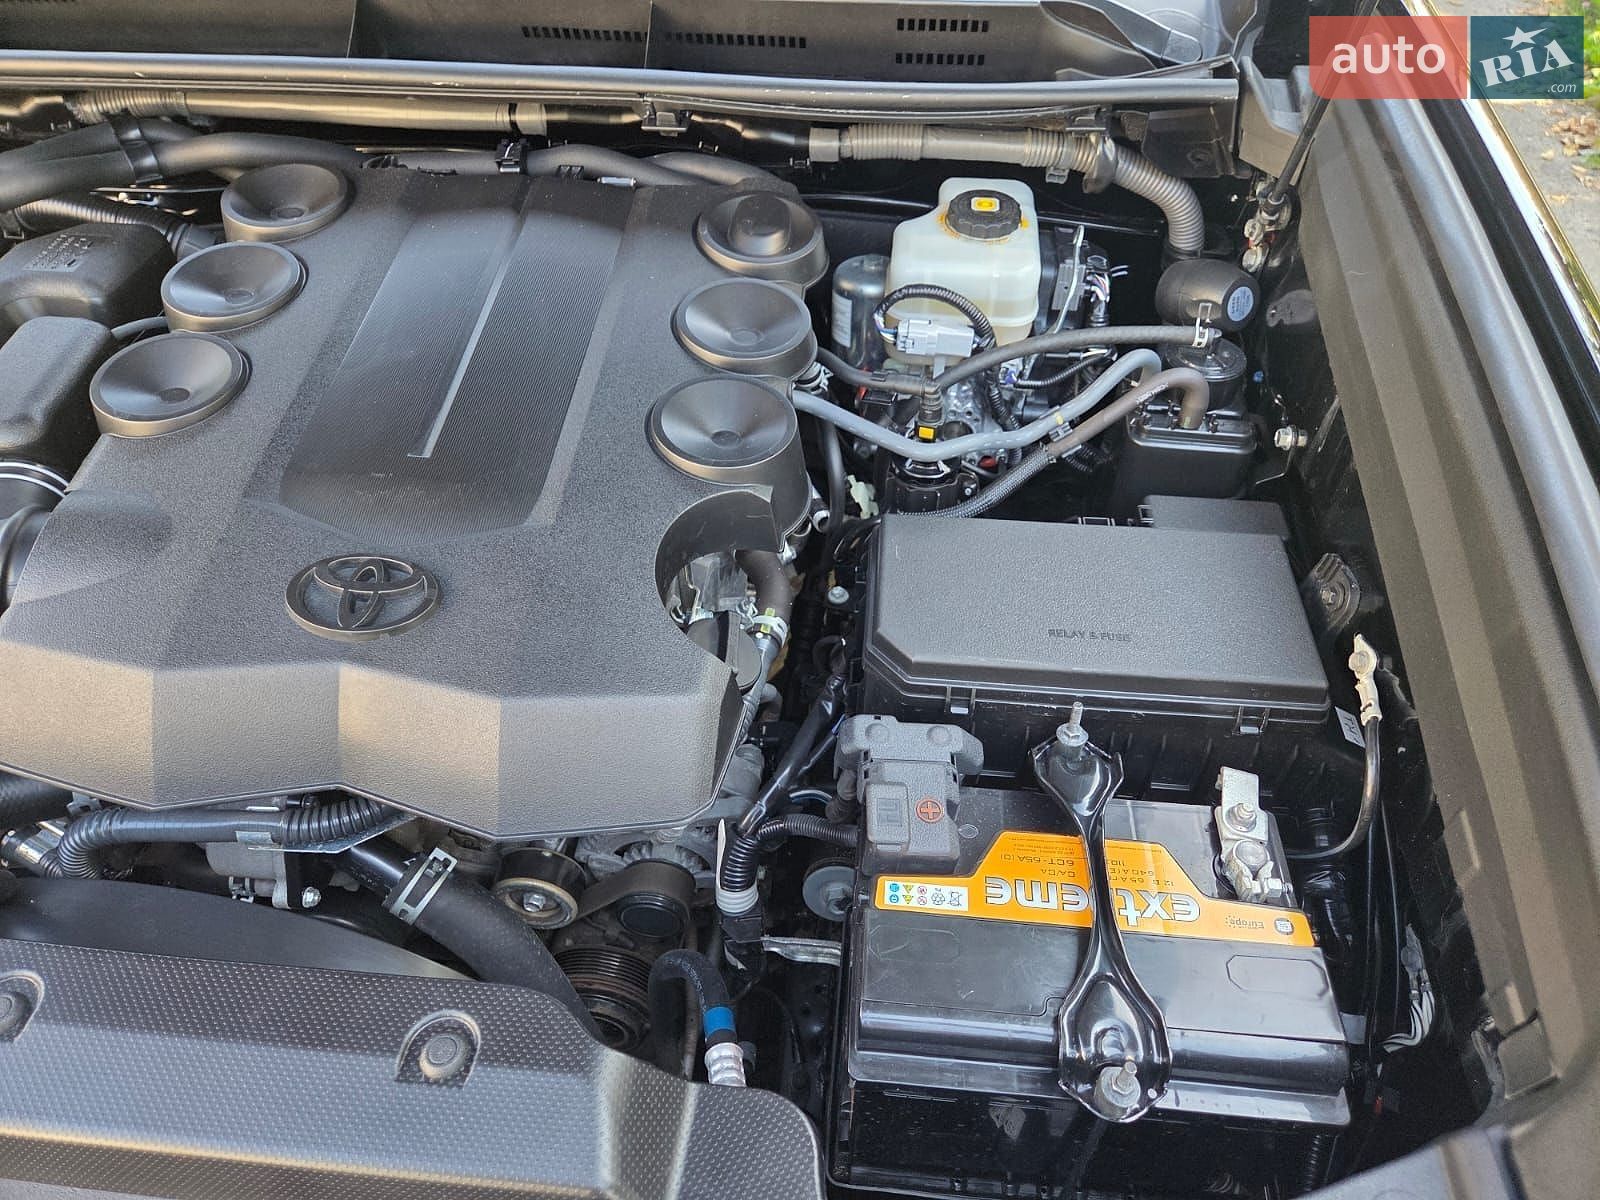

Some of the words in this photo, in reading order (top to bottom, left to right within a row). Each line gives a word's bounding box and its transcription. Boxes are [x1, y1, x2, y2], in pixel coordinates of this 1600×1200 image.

[1048, 628, 1084, 639] RELAY
[1101, 631, 1130, 642] FUSE
[985, 876, 1201, 927] exteme
